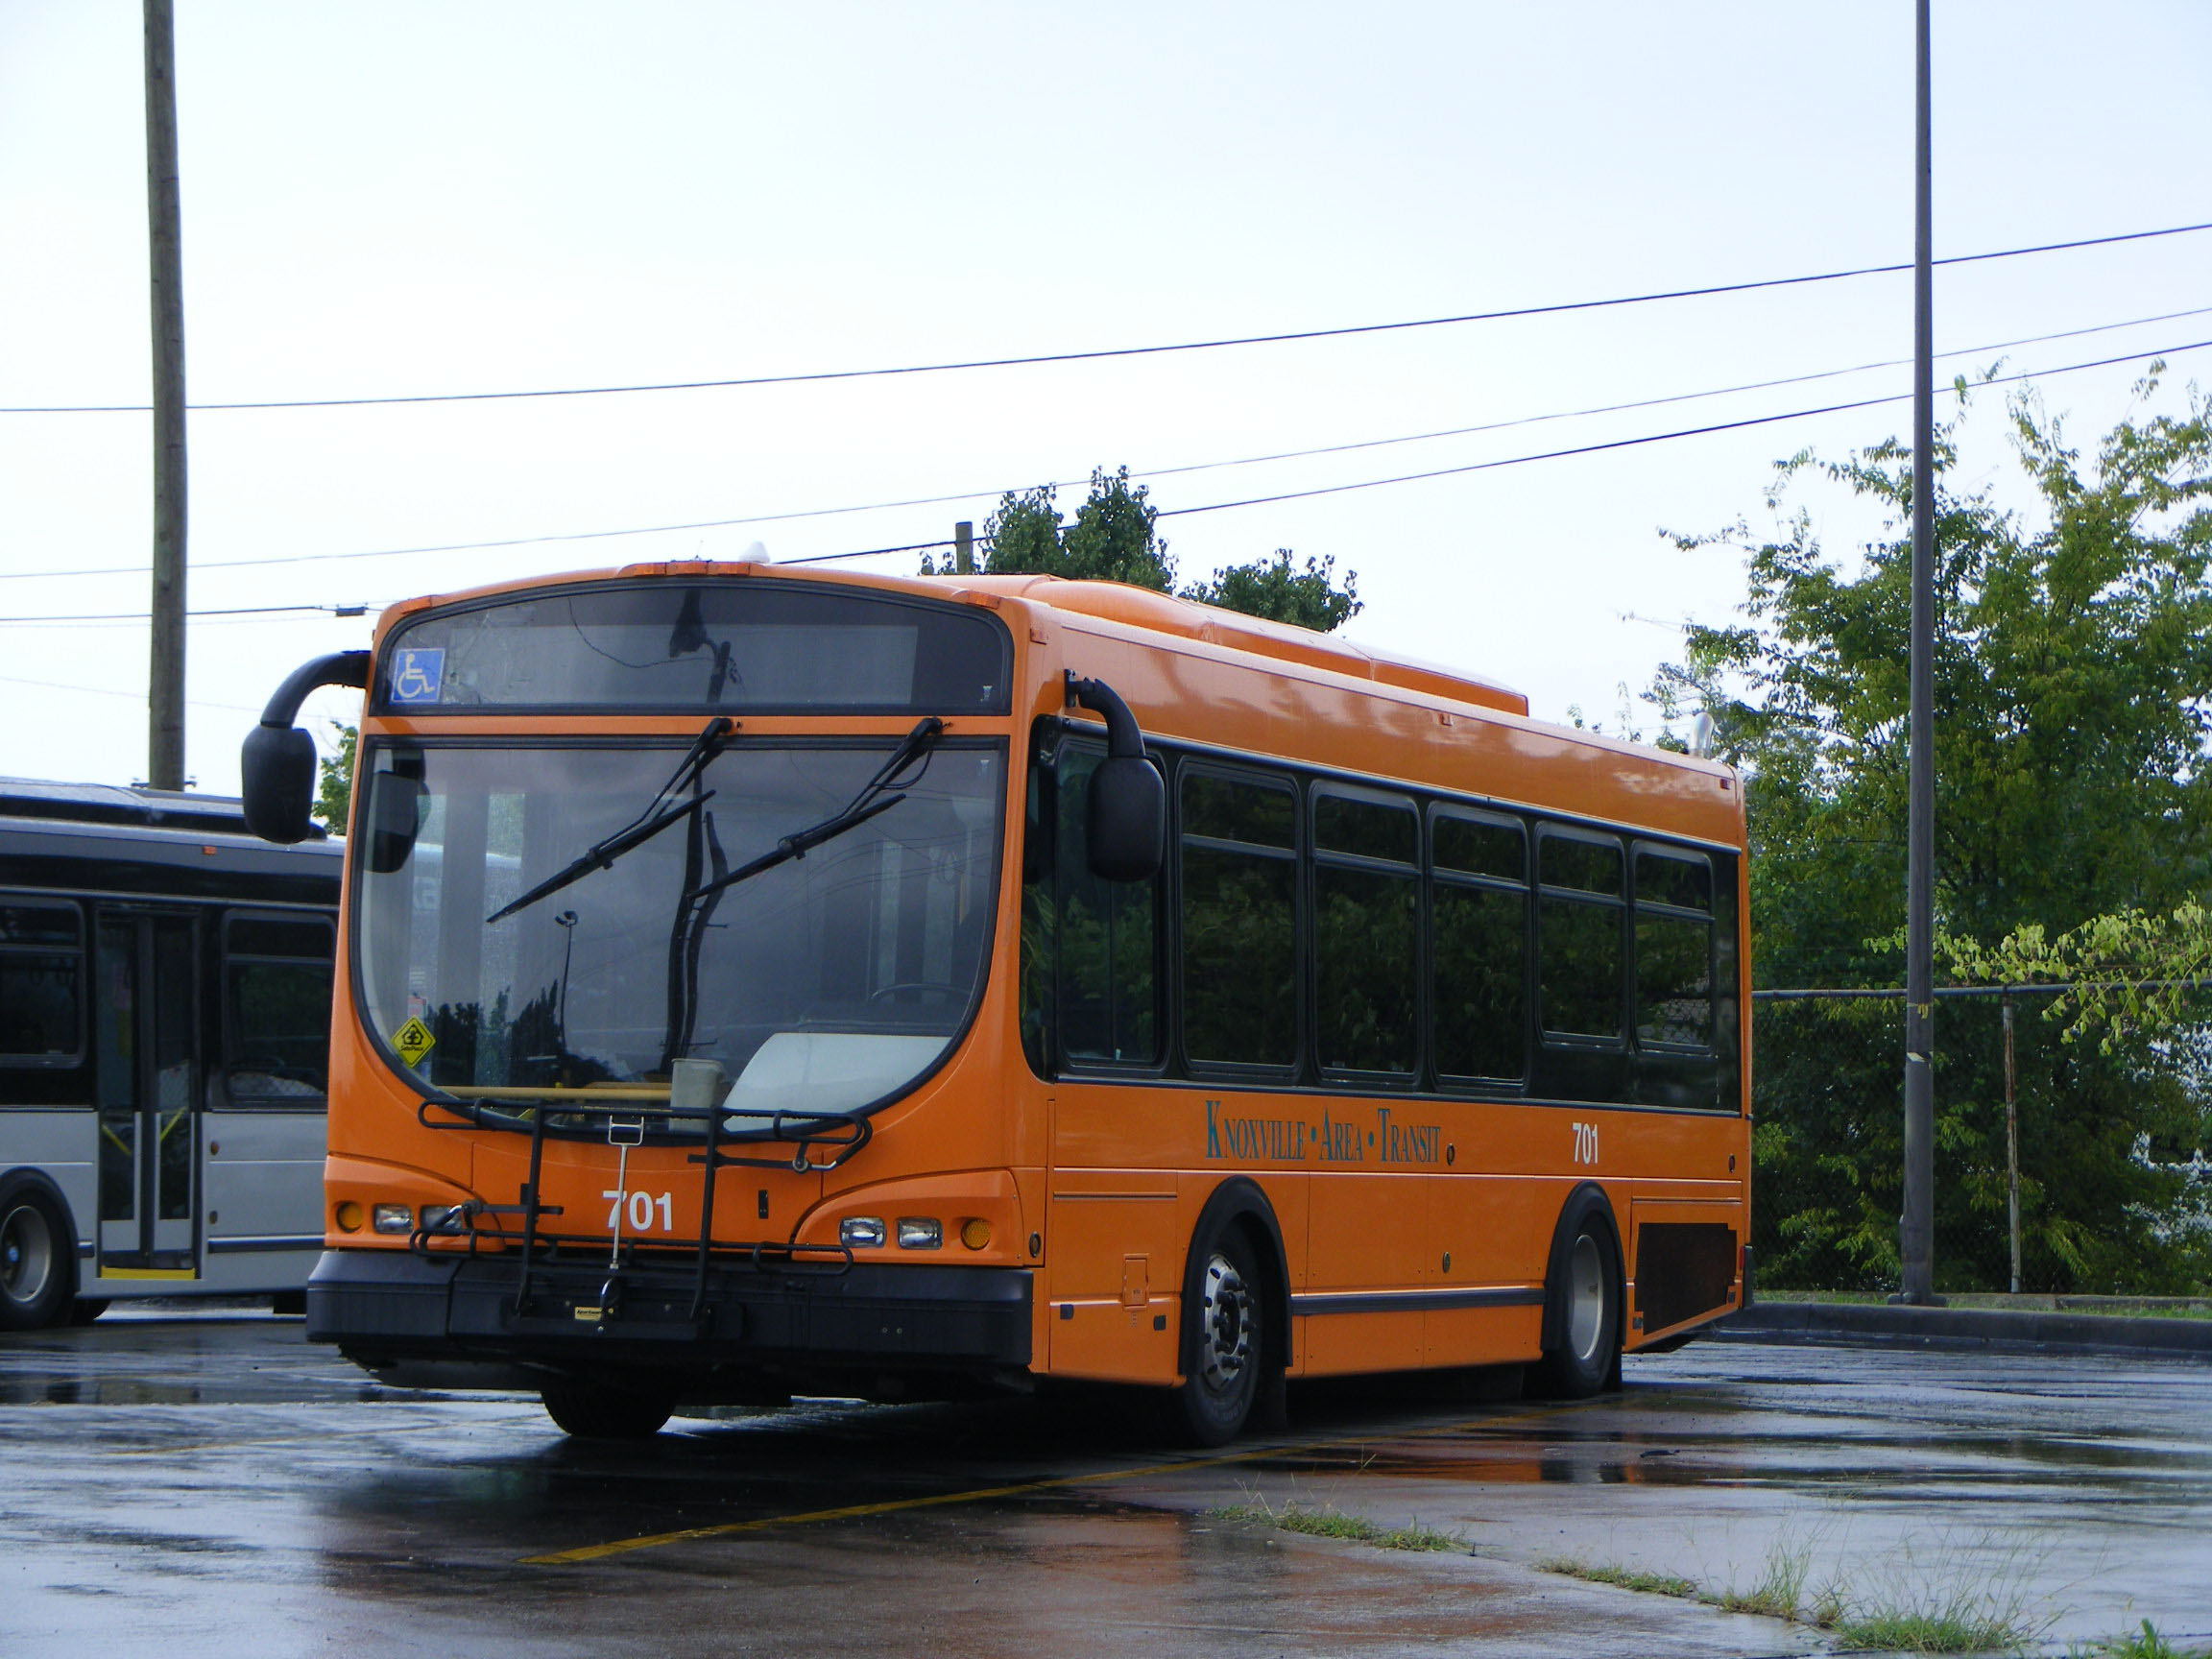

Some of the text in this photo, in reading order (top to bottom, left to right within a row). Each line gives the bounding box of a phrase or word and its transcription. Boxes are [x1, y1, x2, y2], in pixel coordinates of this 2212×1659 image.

[1205, 1100, 1441, 1164] KNOXVILLE AREA TRANSIT
[1572, 1121, 1599, 1165] 701
[602, 1190, 672, 1231] 701
